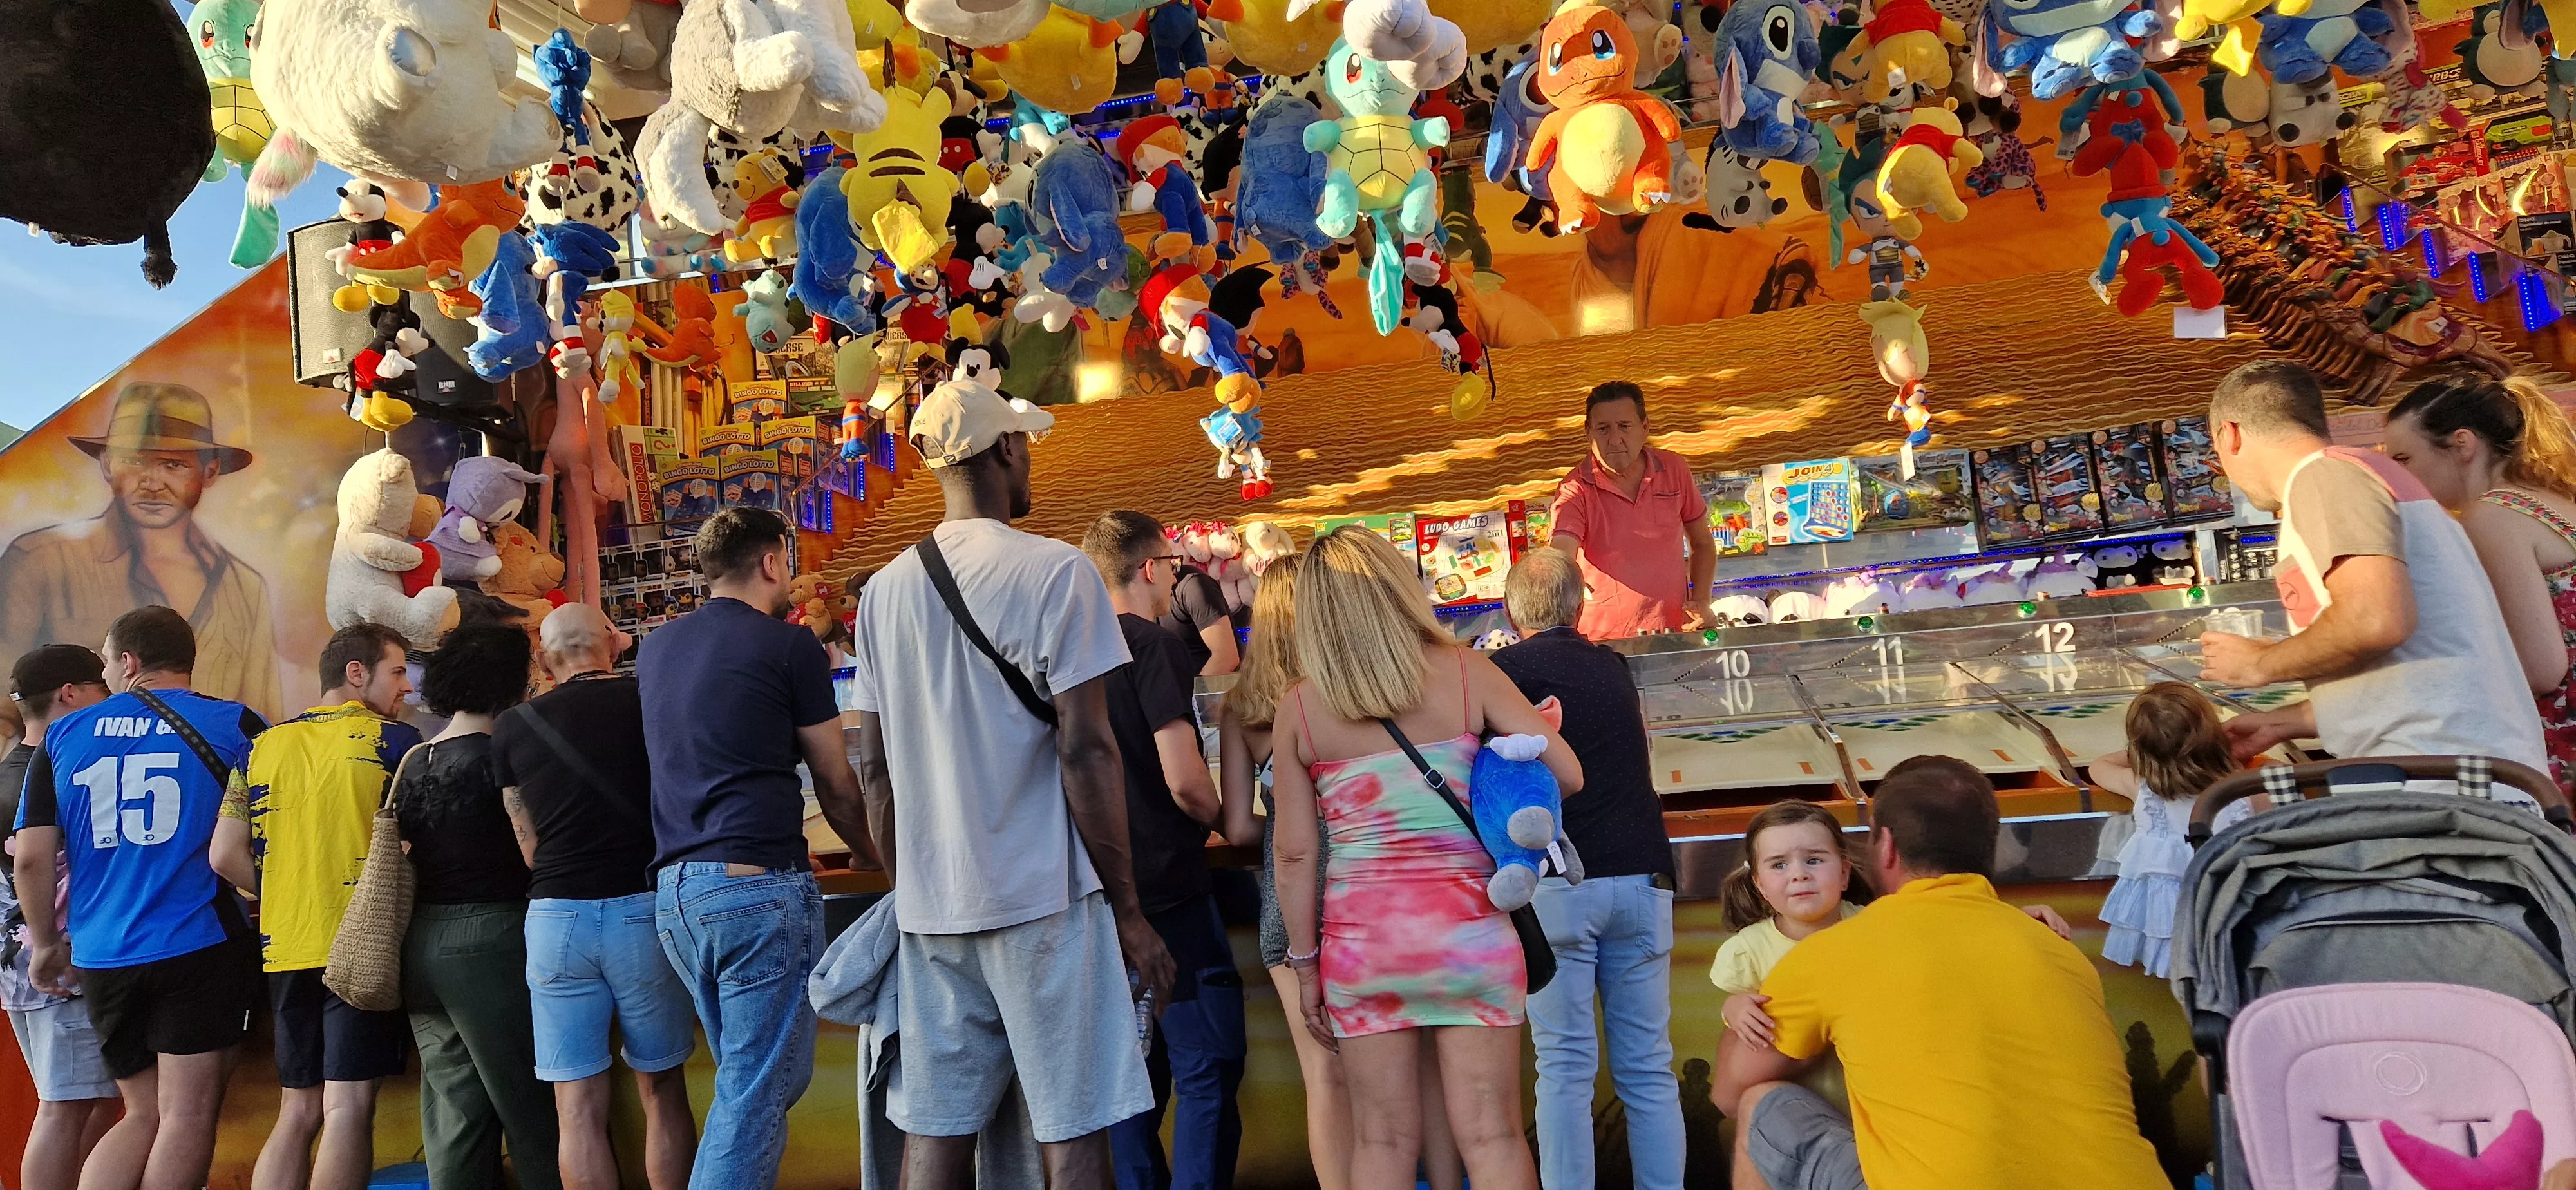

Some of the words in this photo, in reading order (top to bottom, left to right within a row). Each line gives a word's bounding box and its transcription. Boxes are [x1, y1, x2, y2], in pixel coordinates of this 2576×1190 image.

[734, 389, 757, 399] BINGO
[702, 433, 725, 445] BINGO
[764, 428, 787, 439] BINGO
[663, 467, 688, 480] BINGO
[689, 467, 715, 475] LOTTO
[724, 462, 748, 473] BINGO
[1787, 465, 1823, 478] JOIN
[1824, 464, 1832, 472] 4
[632, 444, 654, 522] MONOPOLIO
[2035, 622, 2076, 653] 12
[1871, 636, 1904, 666] 11
[1716, 649, 1750, 679] 10
[93, 717, 152, 737] IVAN
[73, 752, 181, 849] 15
